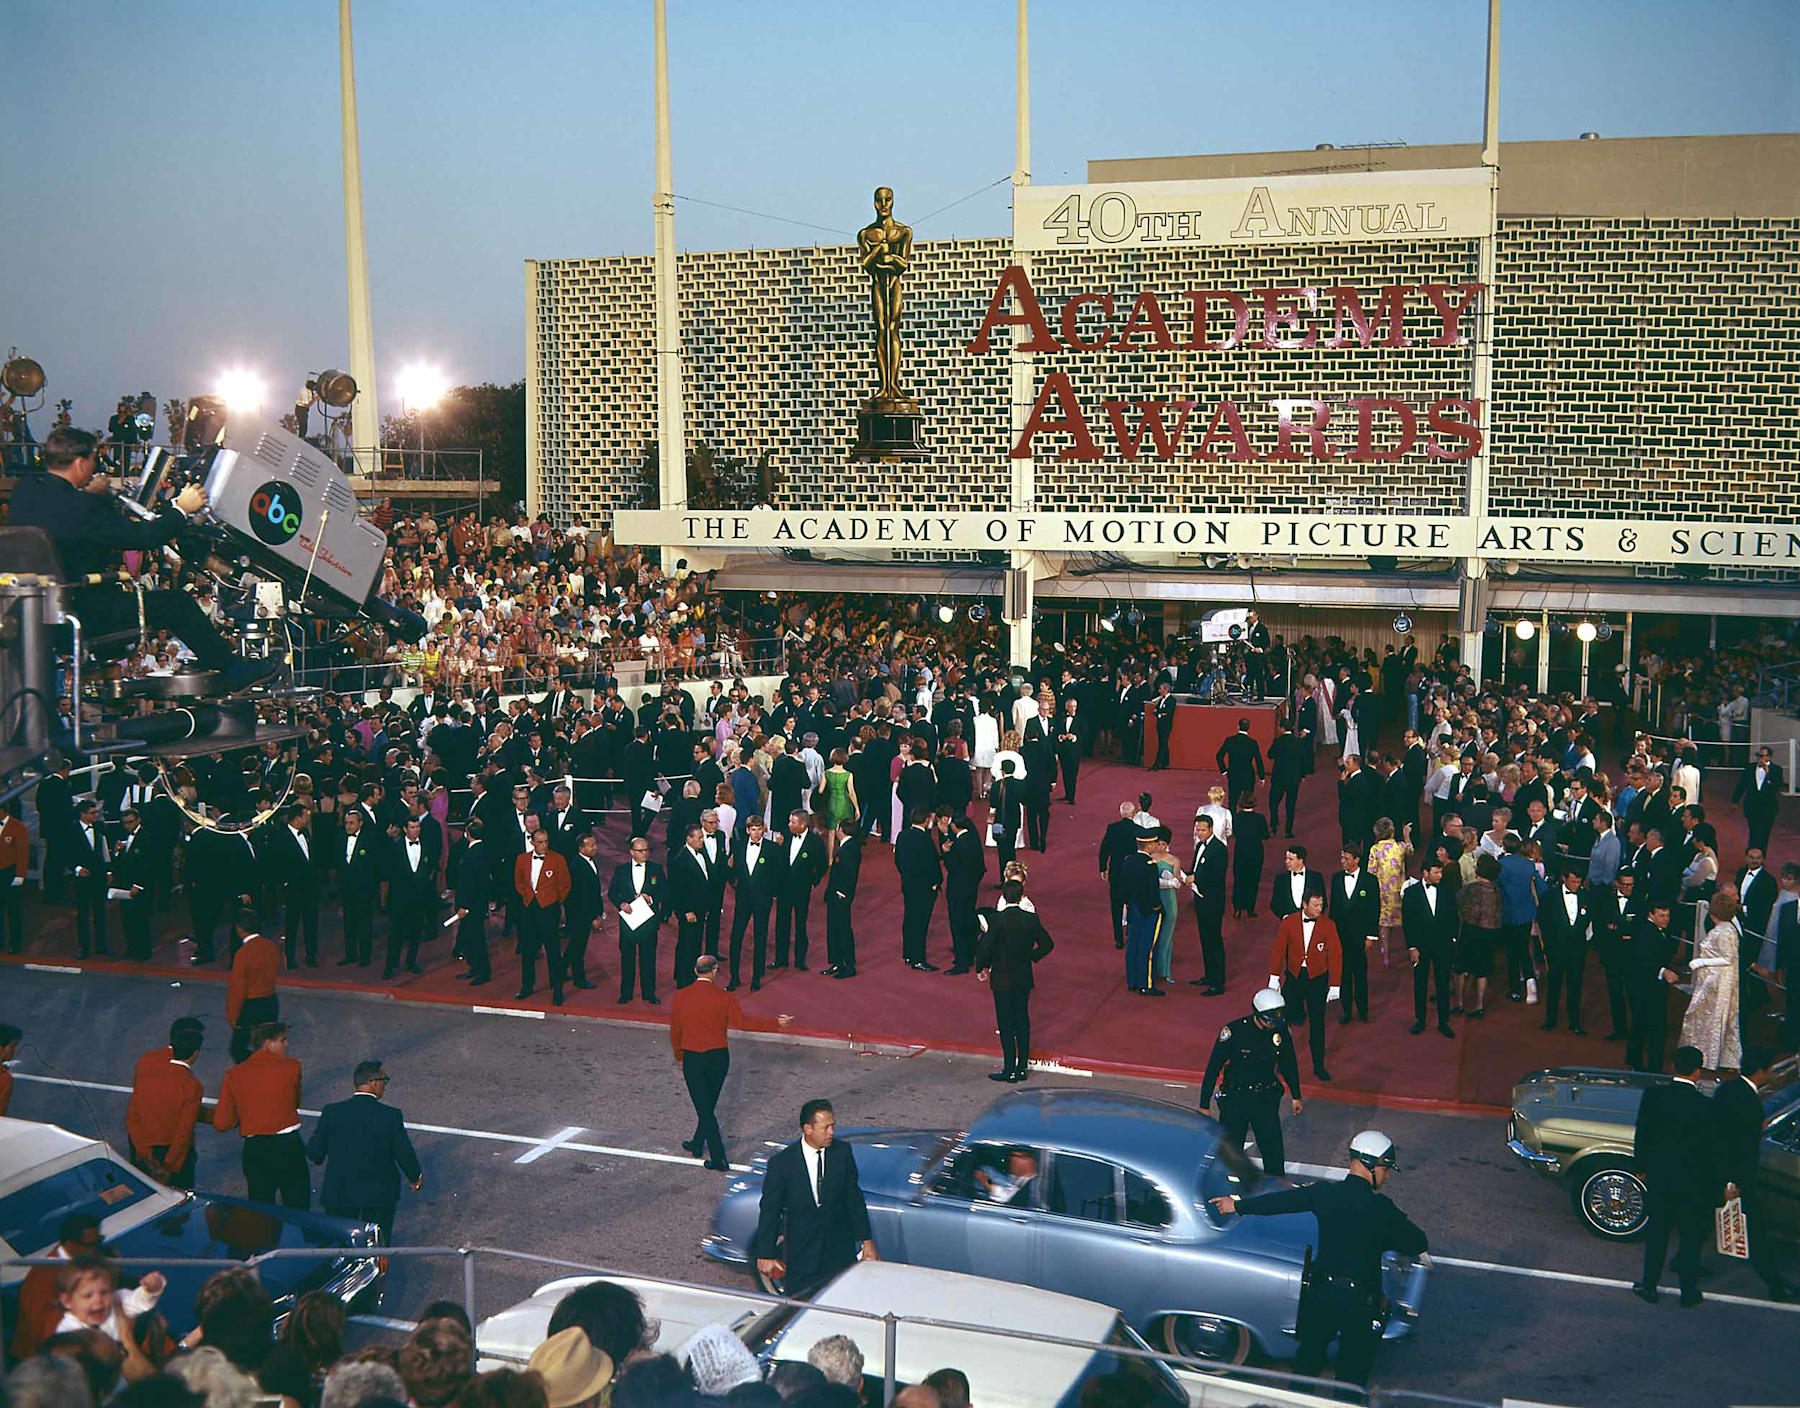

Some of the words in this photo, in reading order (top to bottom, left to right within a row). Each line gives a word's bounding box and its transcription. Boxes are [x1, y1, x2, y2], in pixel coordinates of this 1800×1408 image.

[1043, 192, 1201, 245] 40TH
[1230, 186, 1447, 239] ANNUAL
[966, 265, 1486, 353] ACADEMY
[1008, 372, 1483, 463] AWARDS
[253, 493, 299, 533] abc
[682, 517, 750, 539] THE
[772, 517, 959, 541] ACADEMY
[986, 519, 1036, 542] OF
[1063, 520, 1230, 545] MOTION
[1262, 521, 1450, 548] PICTURE
[1477, 525, 1585, 552] ARTS
[1618, 528, 1638, 553] &
